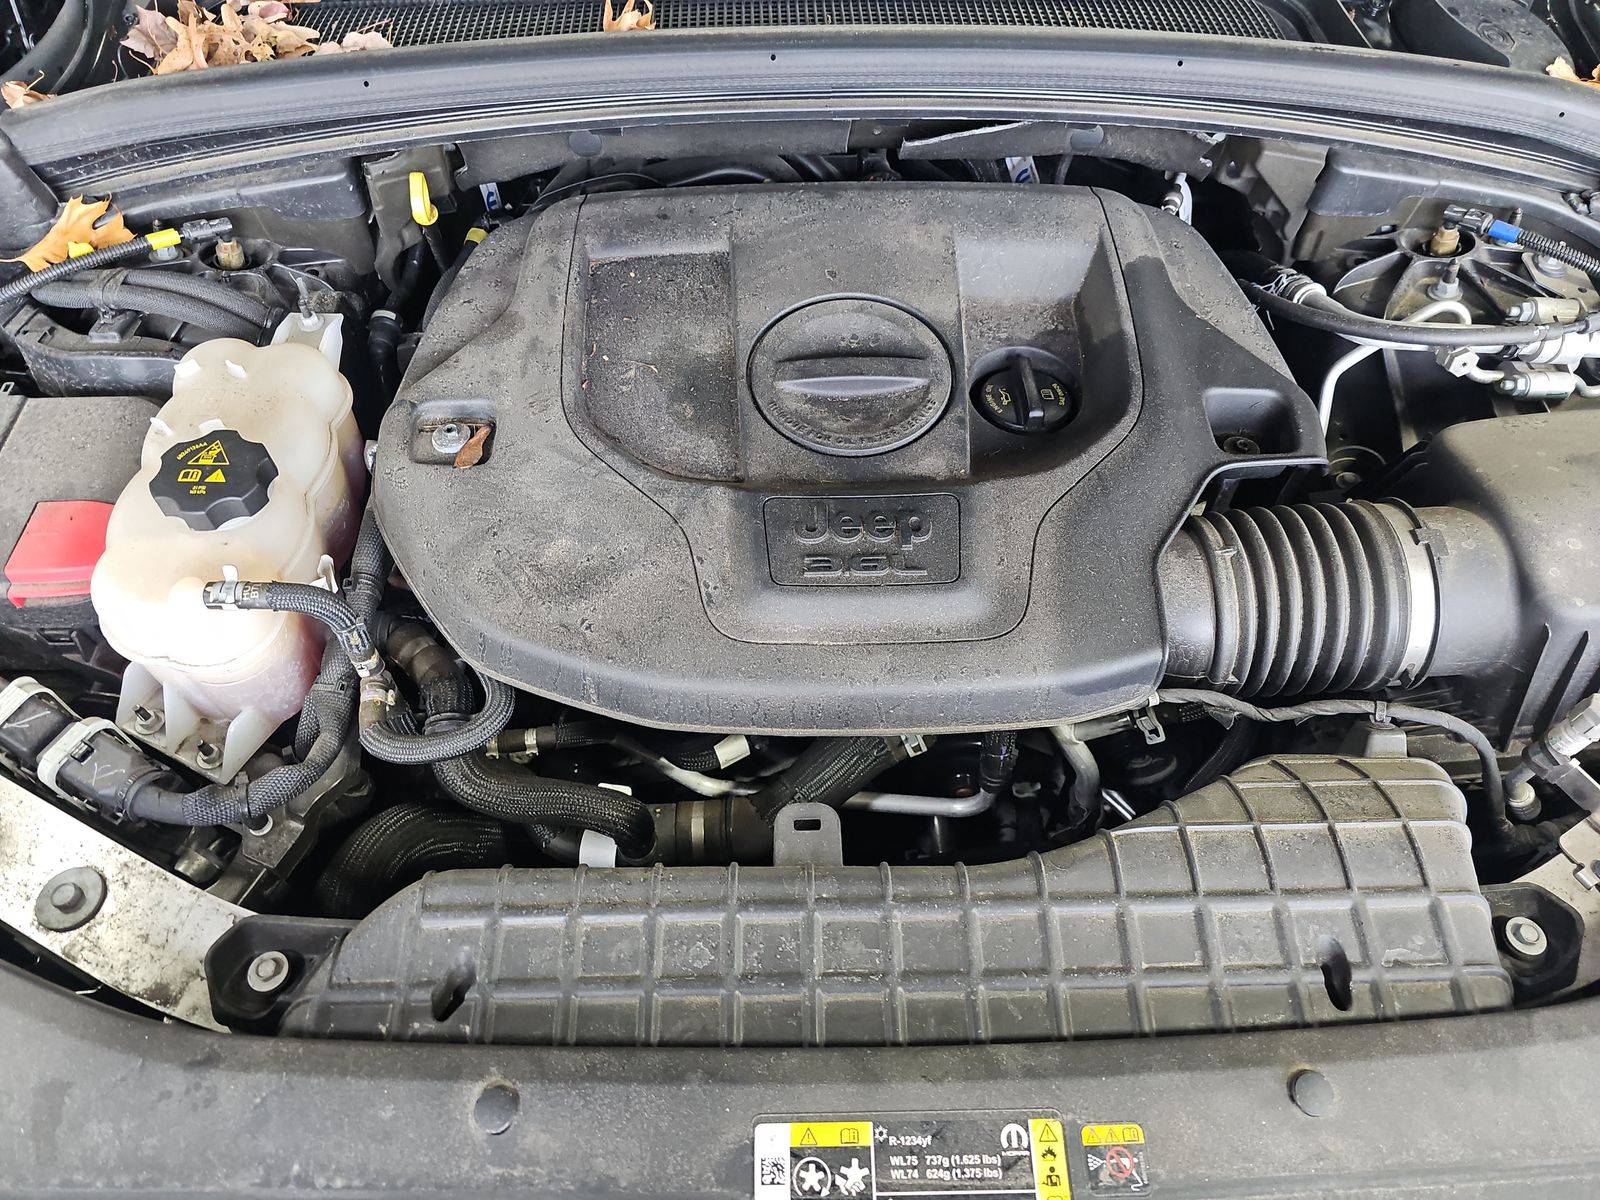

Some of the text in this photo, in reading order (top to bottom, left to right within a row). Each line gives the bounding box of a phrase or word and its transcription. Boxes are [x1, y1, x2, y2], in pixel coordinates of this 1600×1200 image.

[985, 394, 1003, 413] ENGINE
[793, 501, 932, 551] Jeep
[803, 553, 928, 577] 3.6L
[889, 1135, 932, 1148] R-1234yf
[889, 1154, 1002, 1167] WL75 737g (1.625 lbs)
[890, 1167, 1003, 1181] WL74 624g (1.375 lbs)
